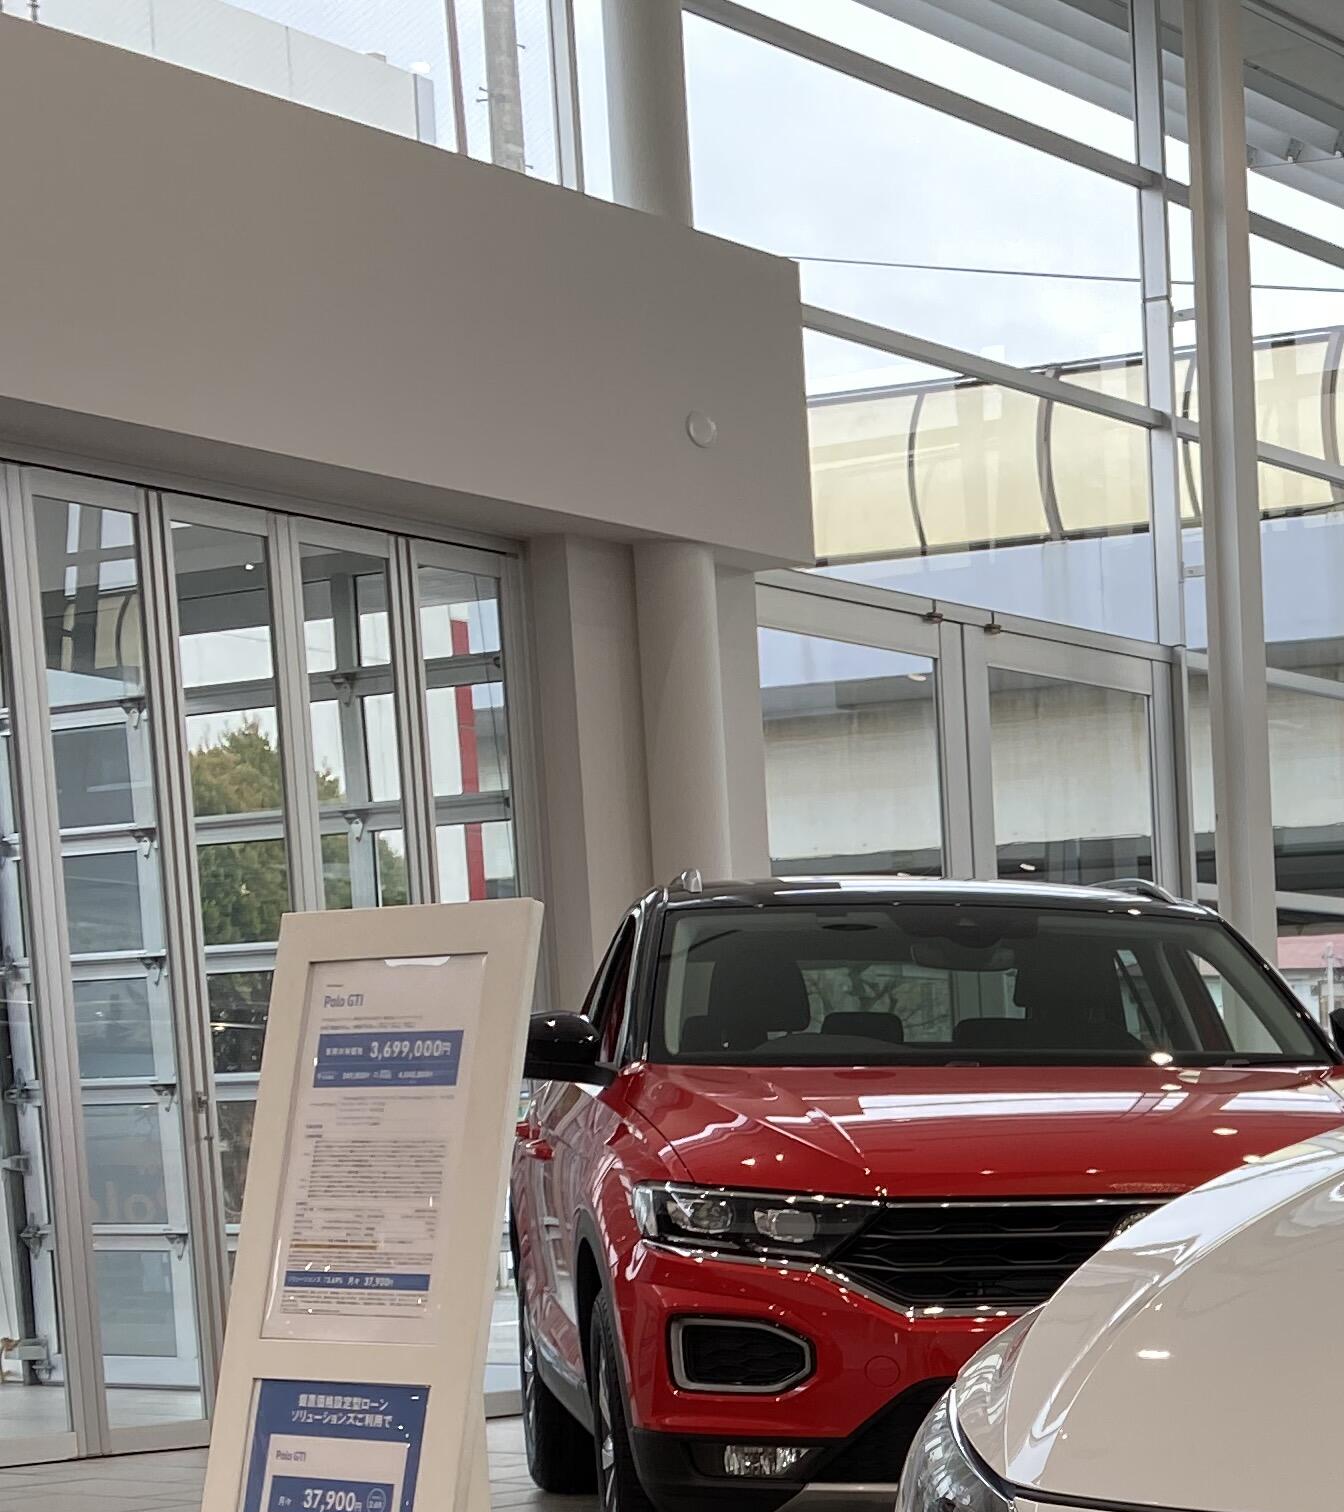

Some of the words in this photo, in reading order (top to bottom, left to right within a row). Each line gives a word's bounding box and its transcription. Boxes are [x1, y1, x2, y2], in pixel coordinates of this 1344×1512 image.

[324, 995, 345, 1008] Polo
[347, 993, 364, 1007] GTI
[369, 1040, 452, 1060] 3,699,000円
[303, 1488, 362, 1512] 37,900円
